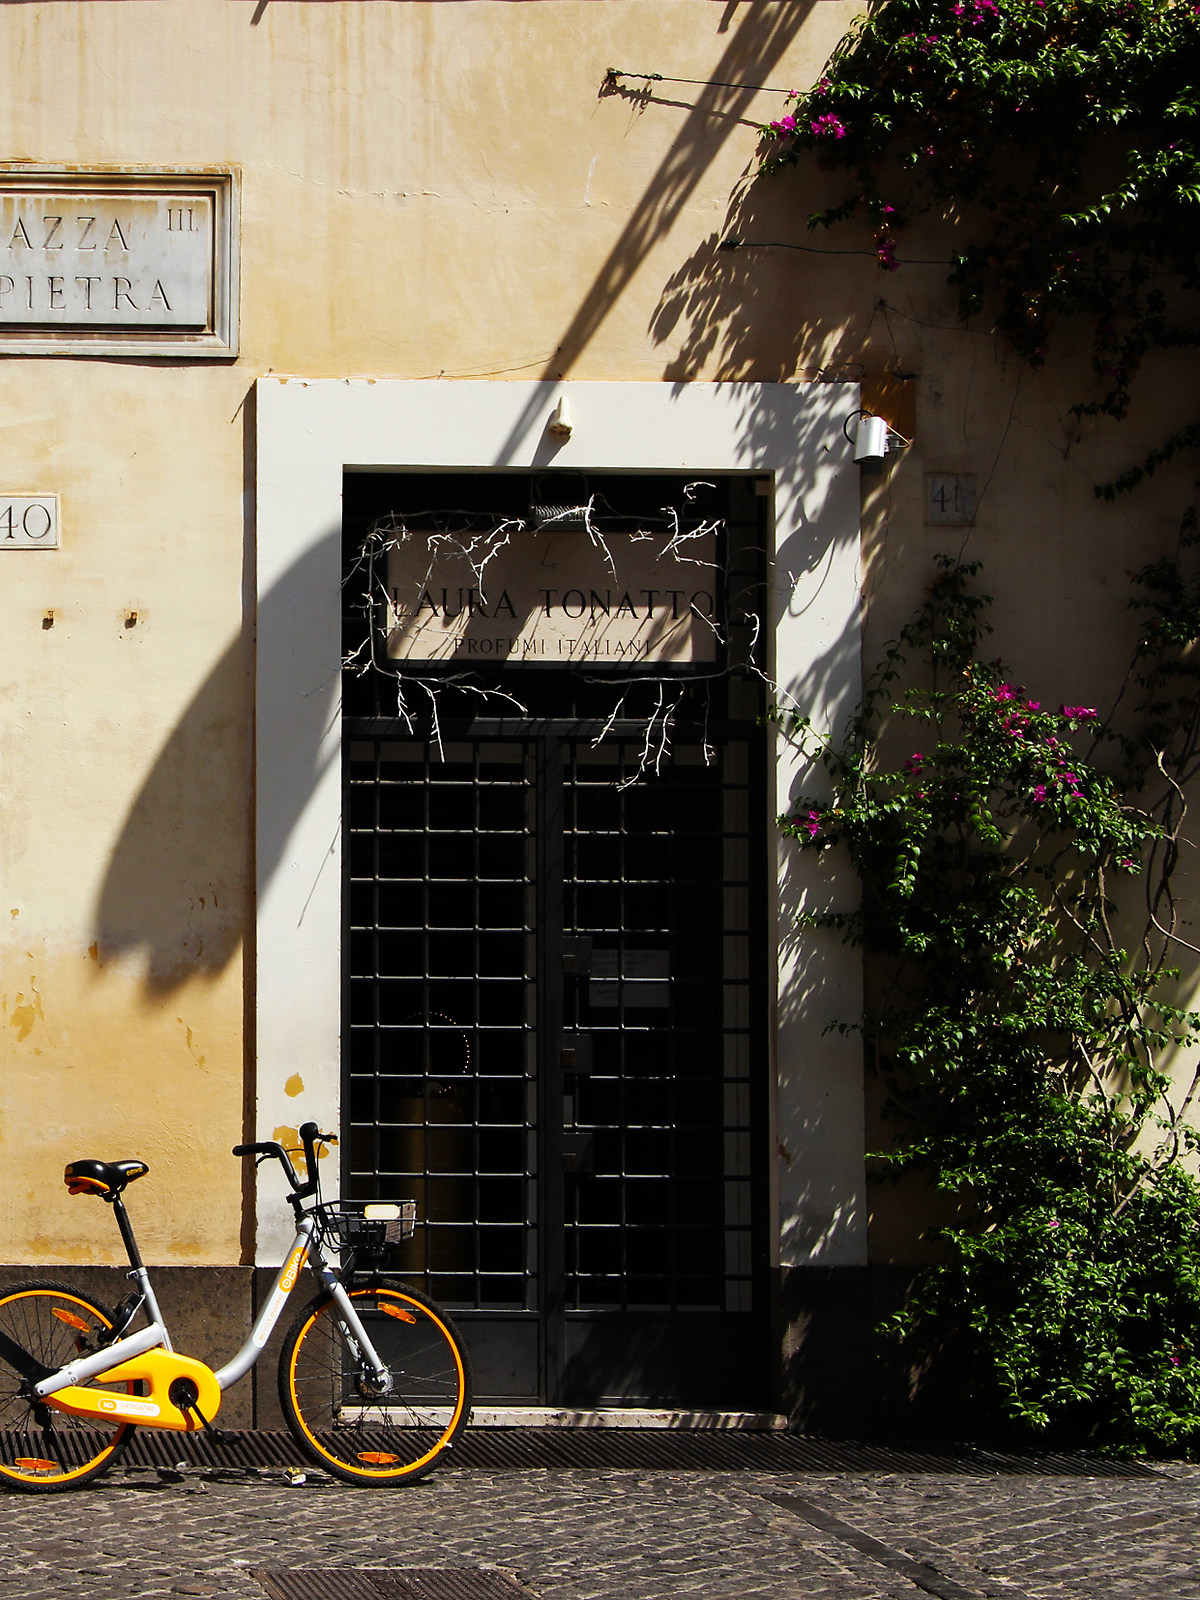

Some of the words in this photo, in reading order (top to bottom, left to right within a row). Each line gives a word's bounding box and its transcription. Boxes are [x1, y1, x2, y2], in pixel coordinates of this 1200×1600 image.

[932, 484, 960, 512] 41
[392, 587, 518, 619] LAURA
[539, 588, 715, 621] TONATTO
[454, 637, 546, 656] PROFUMI
[557, 637, 651, 657] ITALIANI
